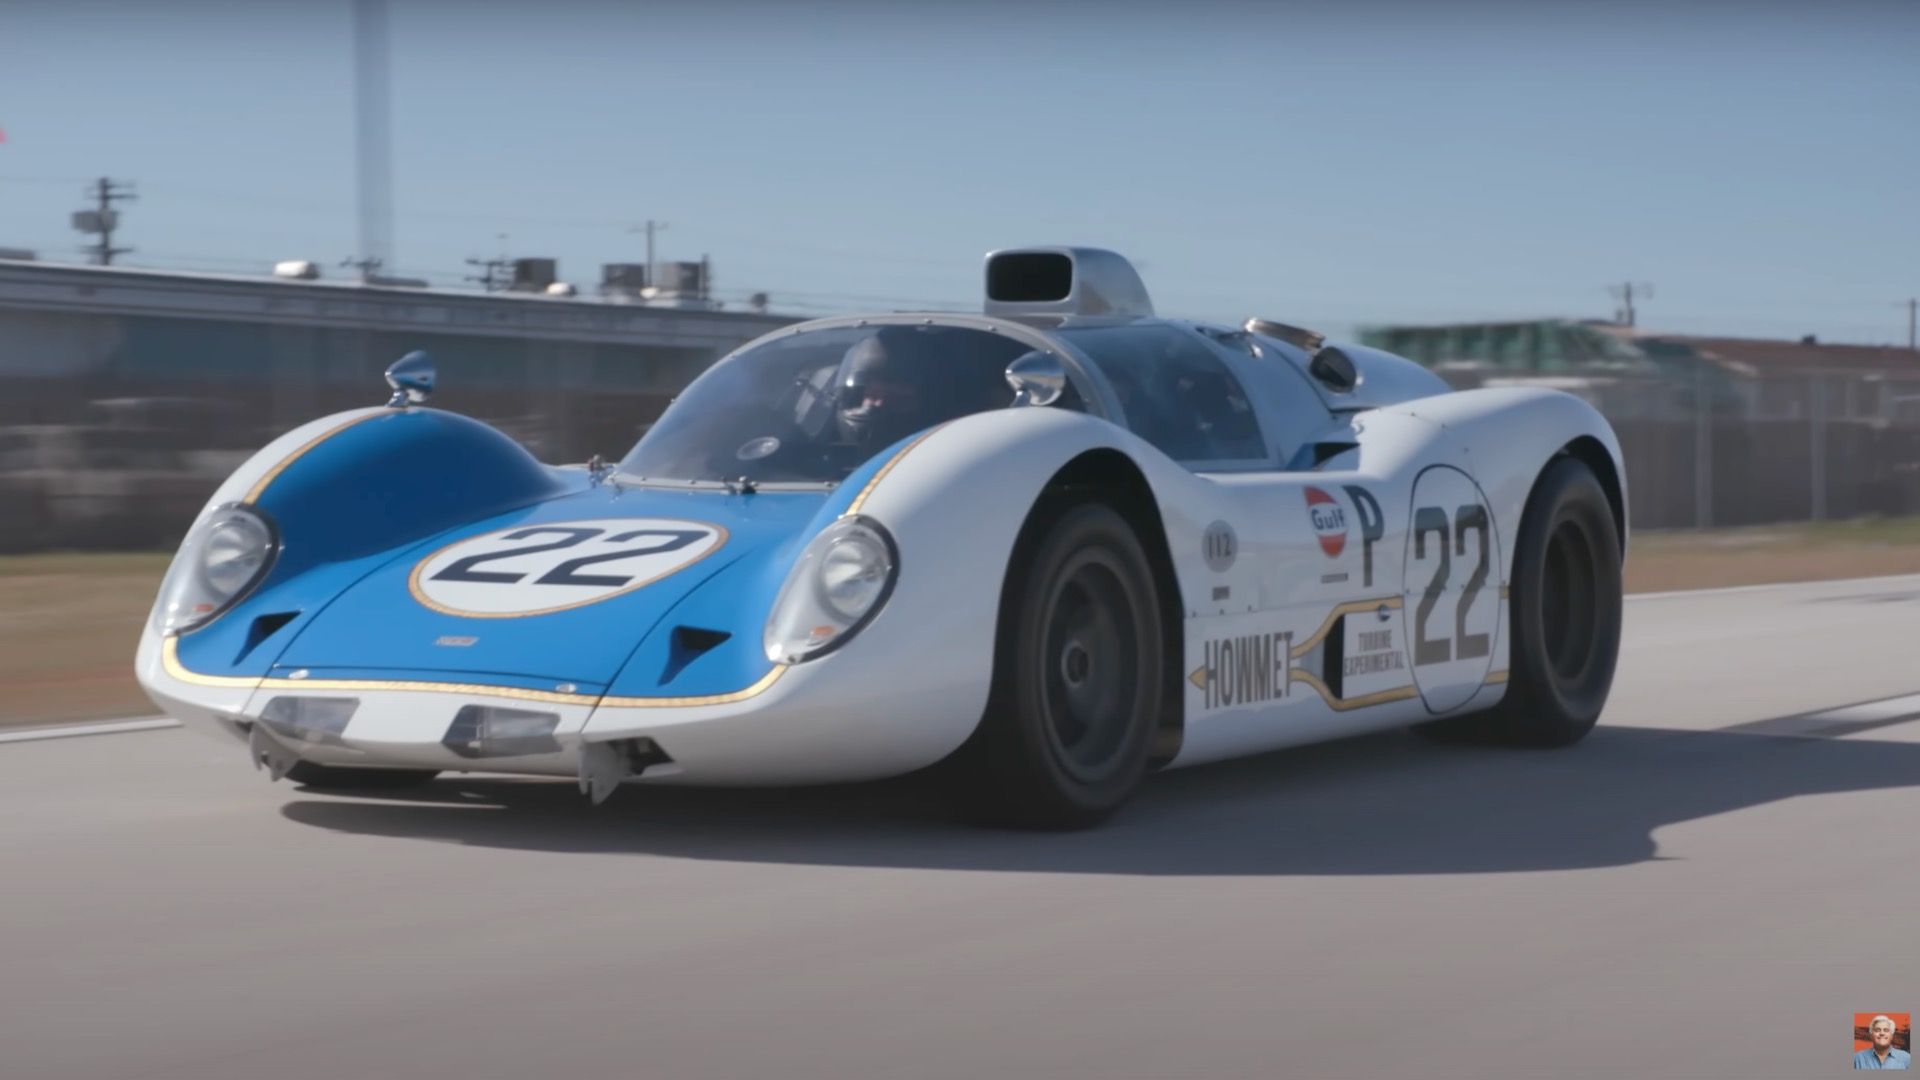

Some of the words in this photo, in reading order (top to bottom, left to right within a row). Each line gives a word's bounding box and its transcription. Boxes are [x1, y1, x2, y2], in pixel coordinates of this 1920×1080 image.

[1311, 508, 1345, 530] Gulf
[1342, 485, 1384, 588] P
[428, 526, 711, 587] 22
[1414, 504, 1490, 666] 22
[1204, 631, 1294, 710] HOWMET
[1344, 650, 1404, 677] EXPERIMENTAL
